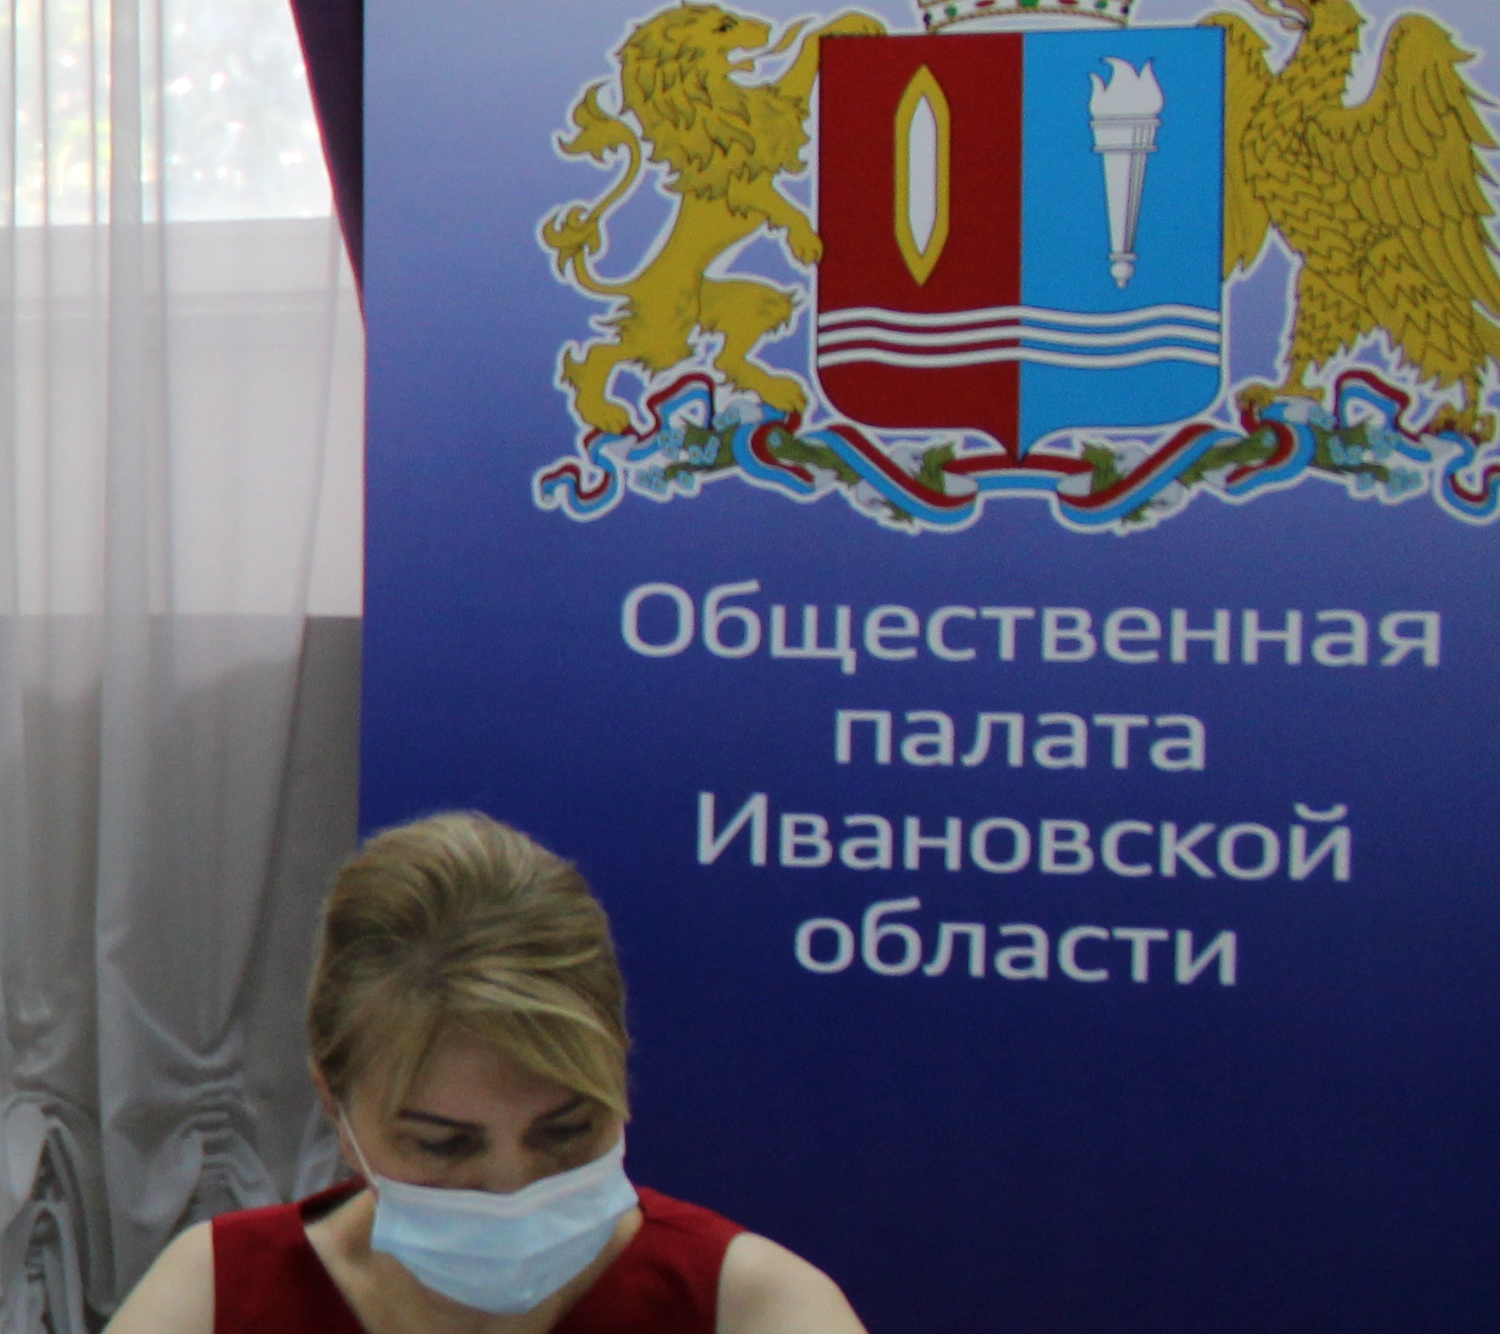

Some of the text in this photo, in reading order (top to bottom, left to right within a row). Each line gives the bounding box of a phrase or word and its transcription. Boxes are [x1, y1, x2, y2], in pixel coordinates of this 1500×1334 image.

[620, 580, 1443, 674] Общественная
[834, 708, 1207, 772] палата
[696, 791, 1353, 882] Ивановской
[794, 898, 1239, 987] области
